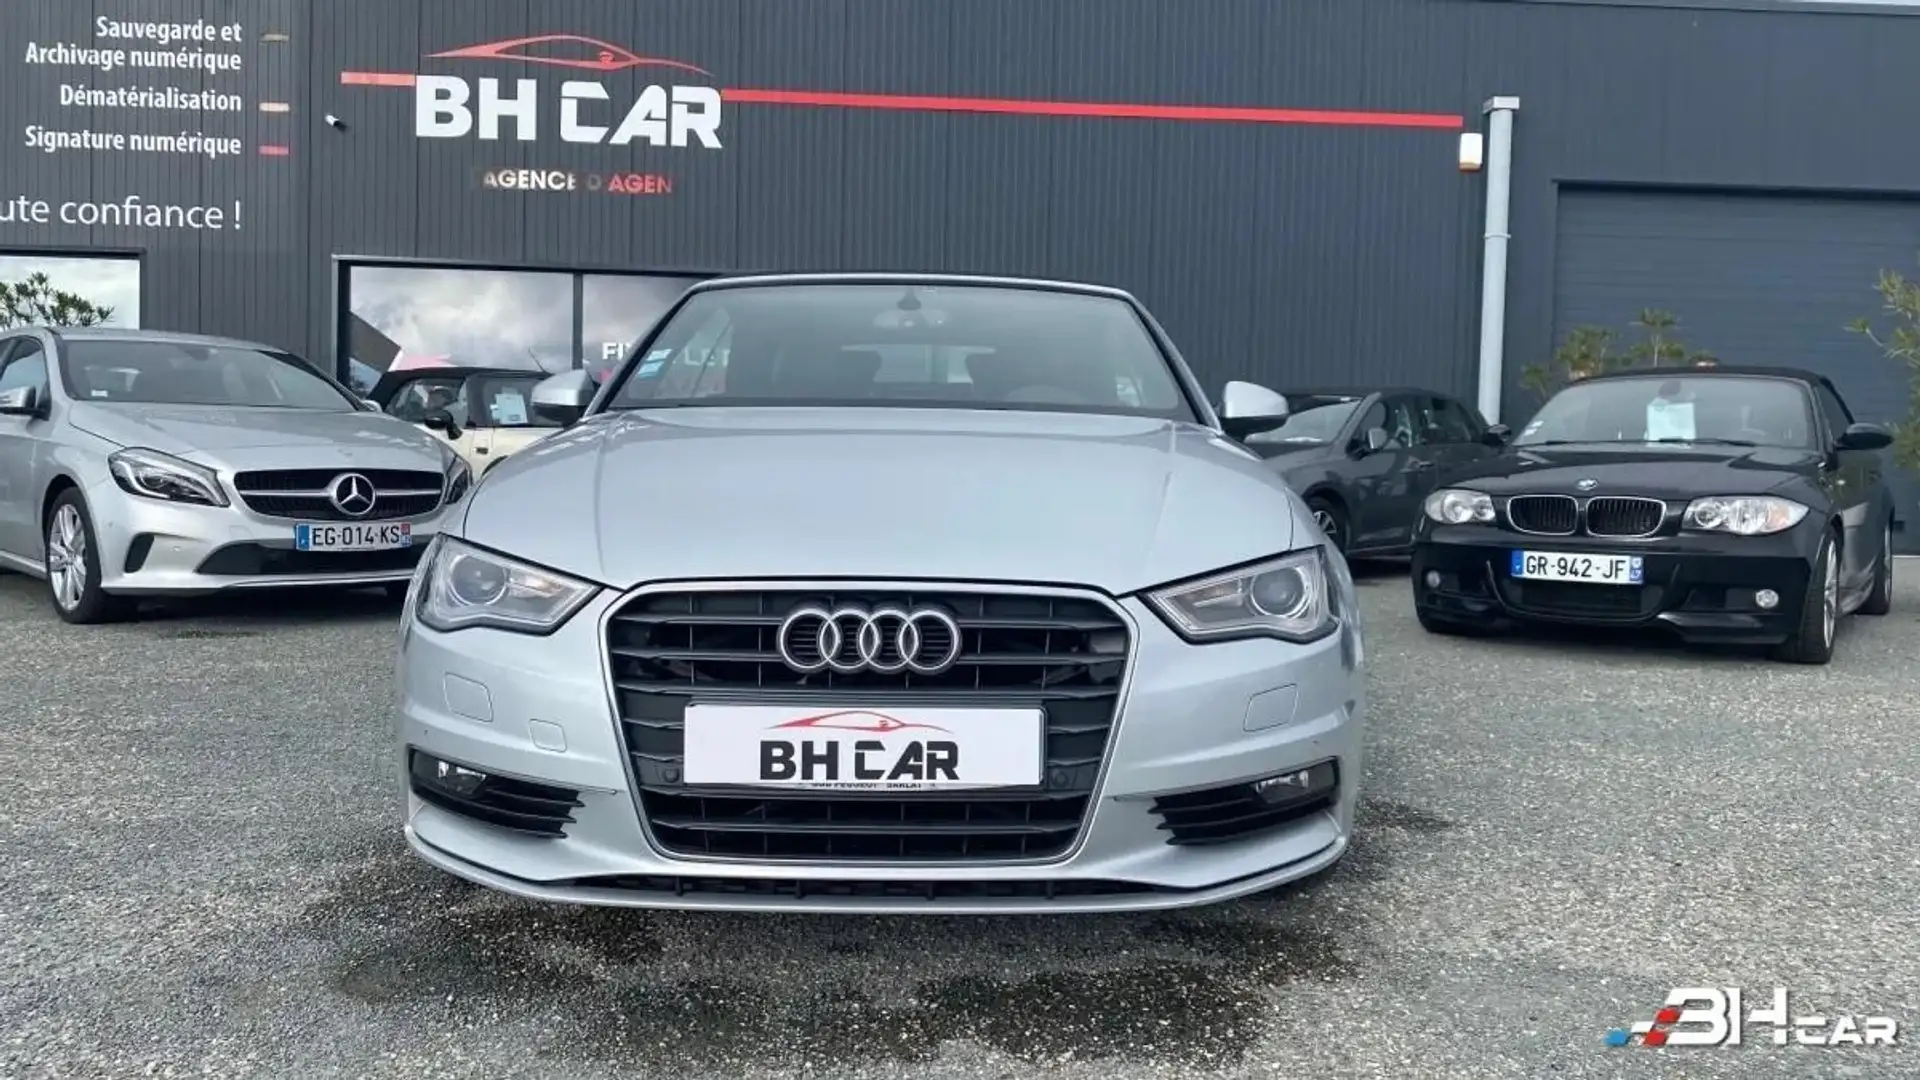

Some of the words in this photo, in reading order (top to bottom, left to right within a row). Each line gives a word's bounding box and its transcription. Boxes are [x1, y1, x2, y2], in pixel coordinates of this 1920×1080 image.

[96, 16, 216, 45] Sauvegarde
[221, 22, 242, 42] et
[25, 42, 125, 71] Archivage
[130, 49, 242, 75] numérique
[60, 84, 242, 112] Dématérialisation
[416, 74, 537, 141] BH
[560, 80, 722, 148] CAR
[25, 125, 124, 152] Signature
[130, 131, 242, 160] numérique
[483, 169, 576, 191] AGENCE
[60, 195, 224, 229] confiance
[312, 525, 399, 545] EG-014-KS
[1526, 555, 1626, 579] GR-942-JF
[760, 741, 838, 781] BH
[855, 740, 960, 781] CAR
